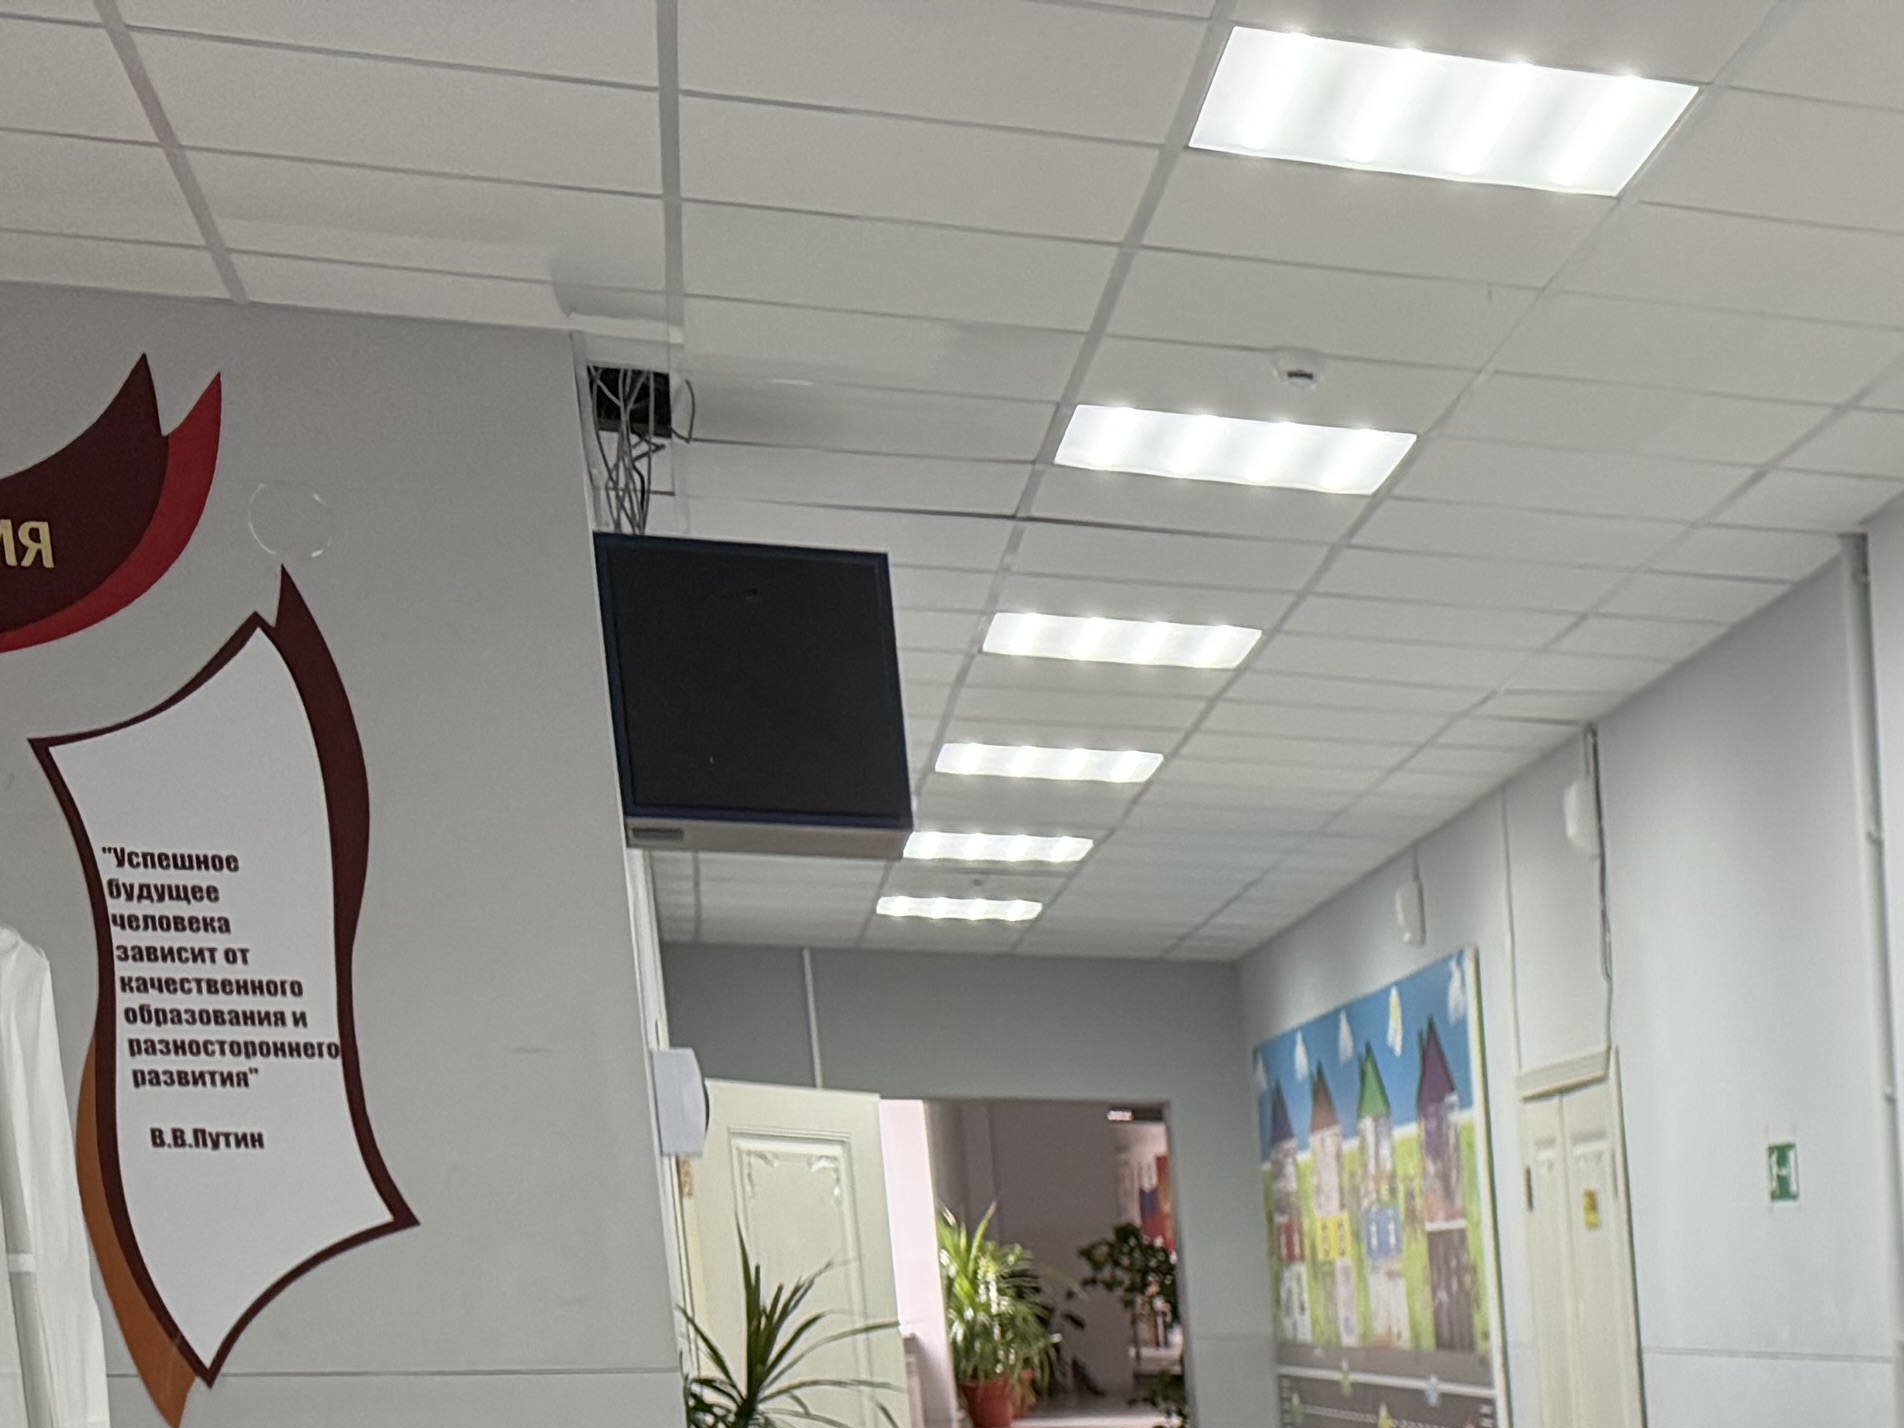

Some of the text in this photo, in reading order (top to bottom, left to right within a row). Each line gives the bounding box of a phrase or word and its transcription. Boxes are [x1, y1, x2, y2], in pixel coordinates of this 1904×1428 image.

[101, 846, 240, 872] "Успешное
[107, 878, 220, 905] будущее
[111, 913, 231, 934] человека
[115, 944, 251, 965] зависит от
[119, 976, 304, 998] качественного
[123, 1004, 308, 1028] образования и
[127, 1037, 341, 1059] разностороннего
[132, 1067, 259, 1088] развития"
[150, 1125, 265, 1153] В.В.Путин
